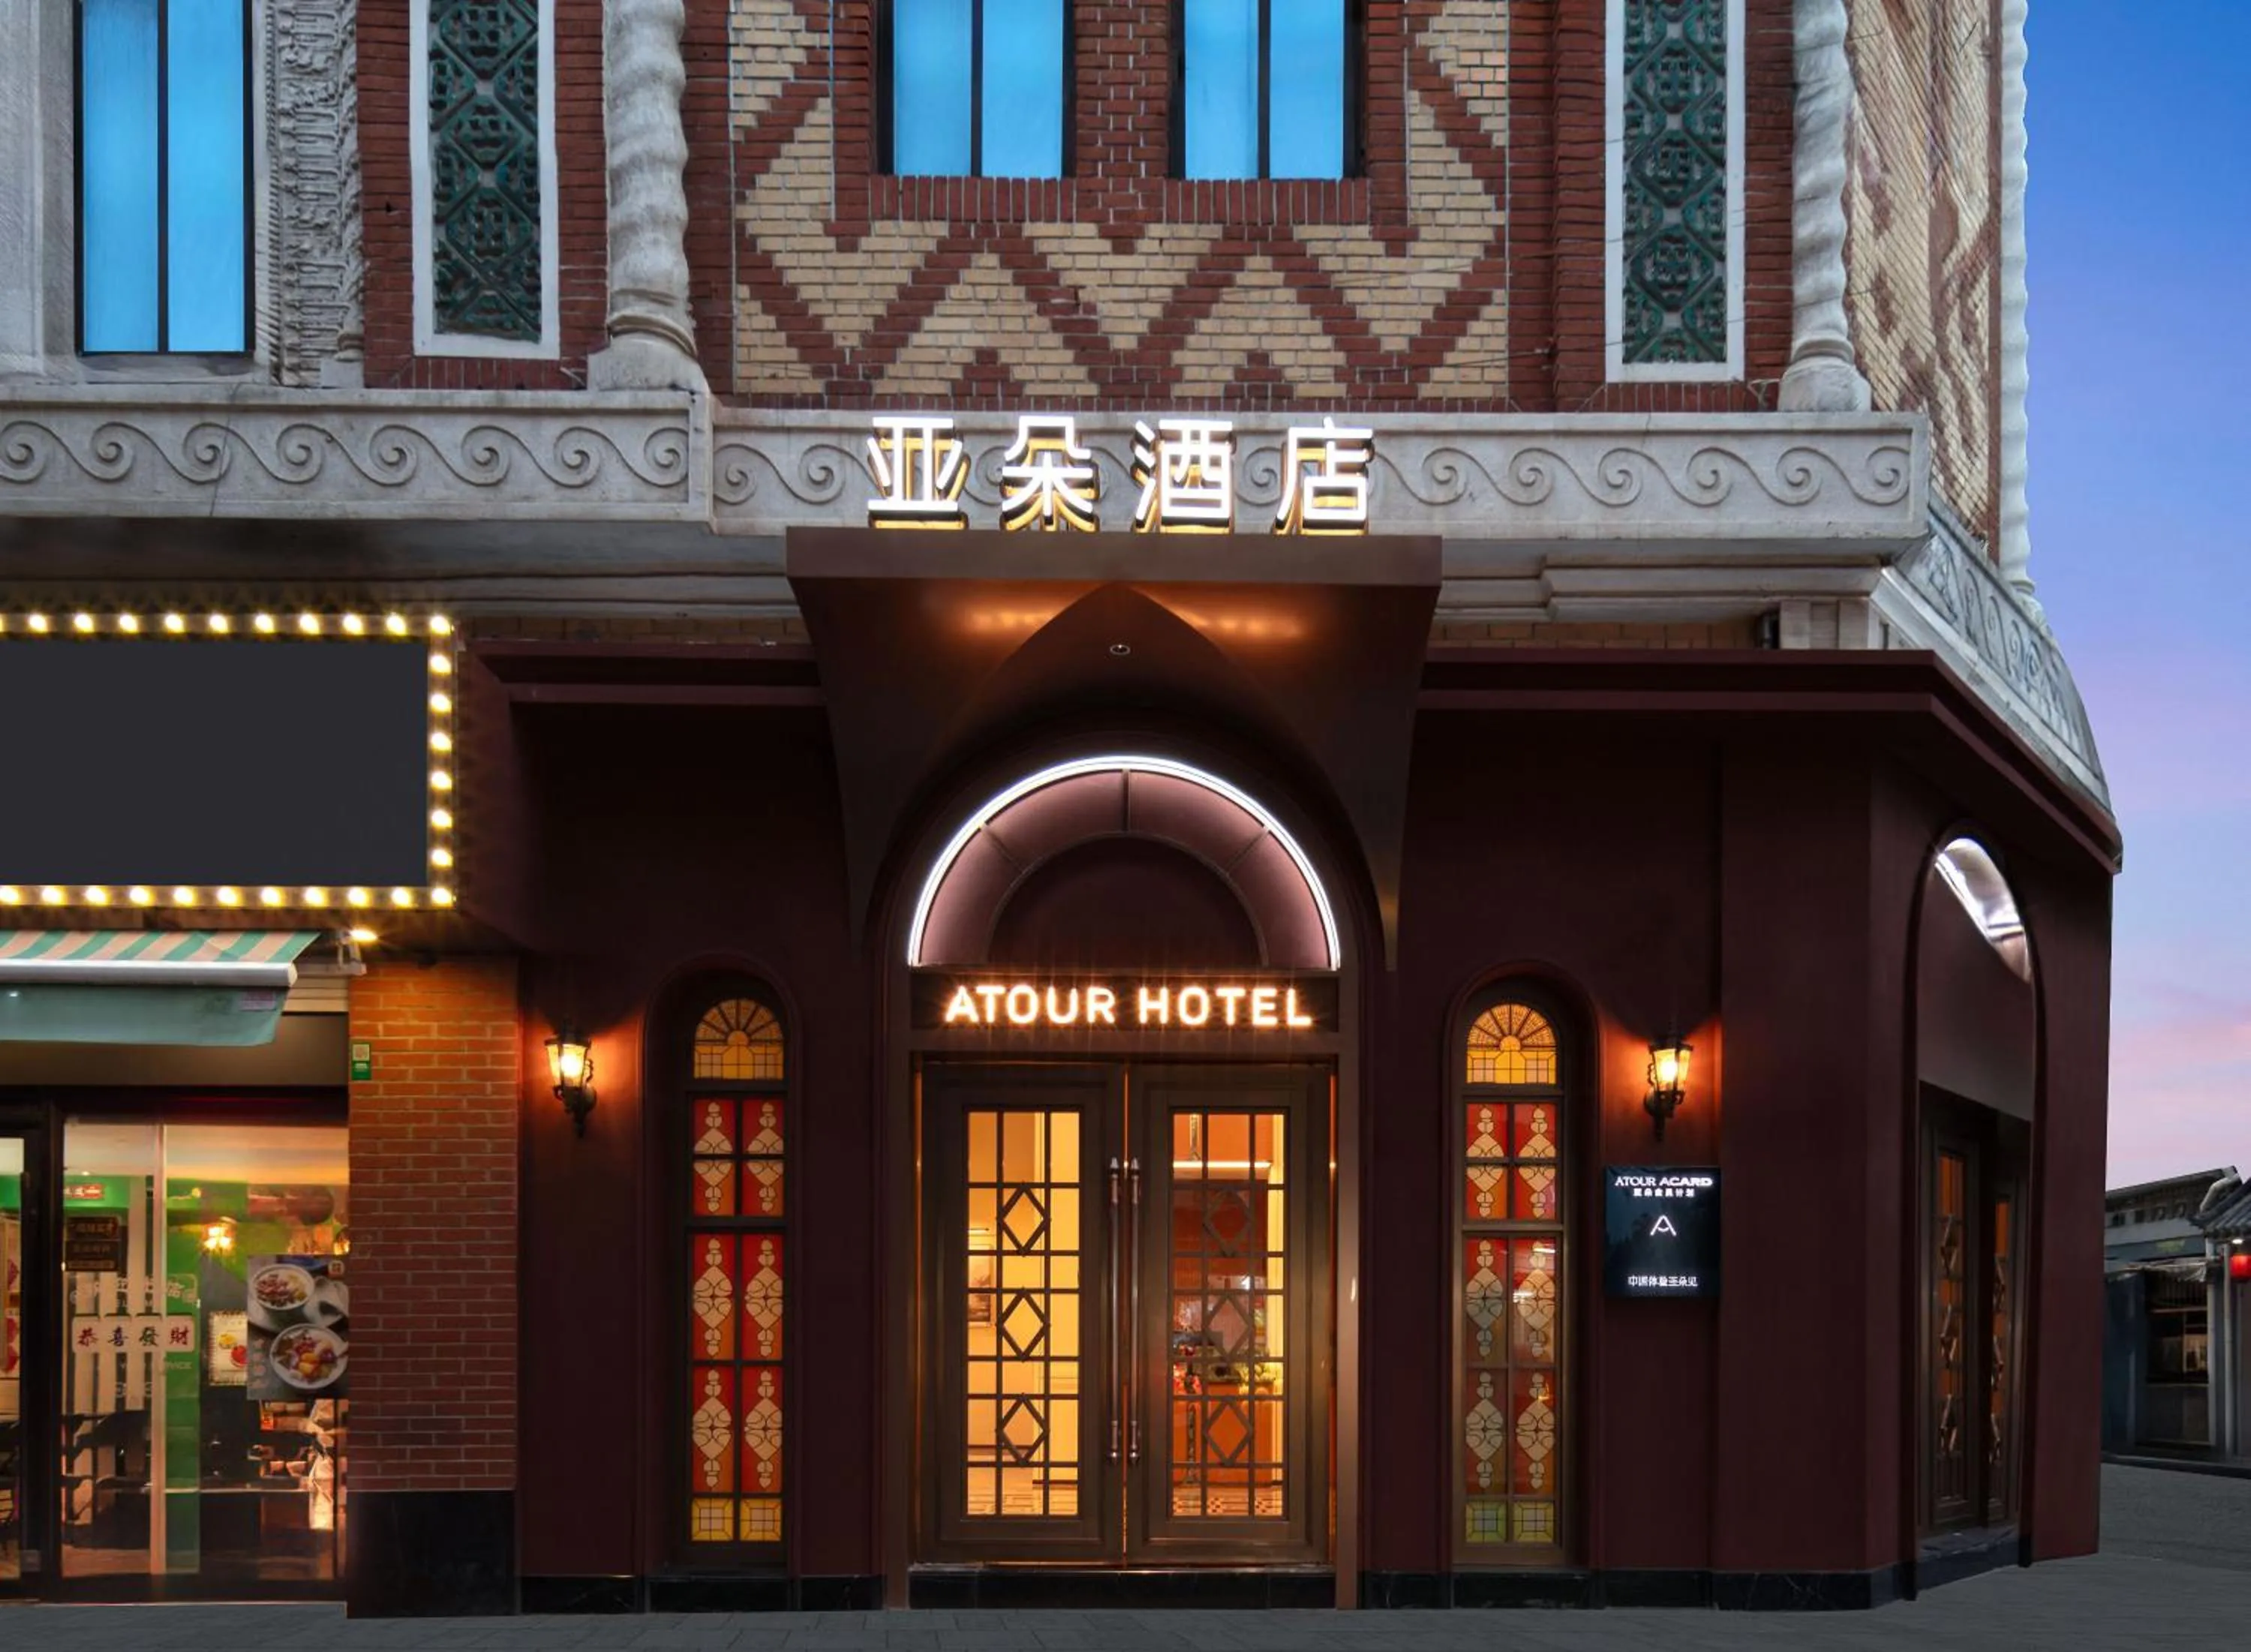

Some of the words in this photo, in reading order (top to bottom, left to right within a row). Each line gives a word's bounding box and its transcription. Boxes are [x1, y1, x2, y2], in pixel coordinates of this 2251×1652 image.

[867, 416, 1373, 522] 亚朵酒店
[945, 985, 1116, 1025] ATOUR
[1138, 986, 1313, 1027] HOTEL
[1615, 1176, 1657, 1186] ATOUR
